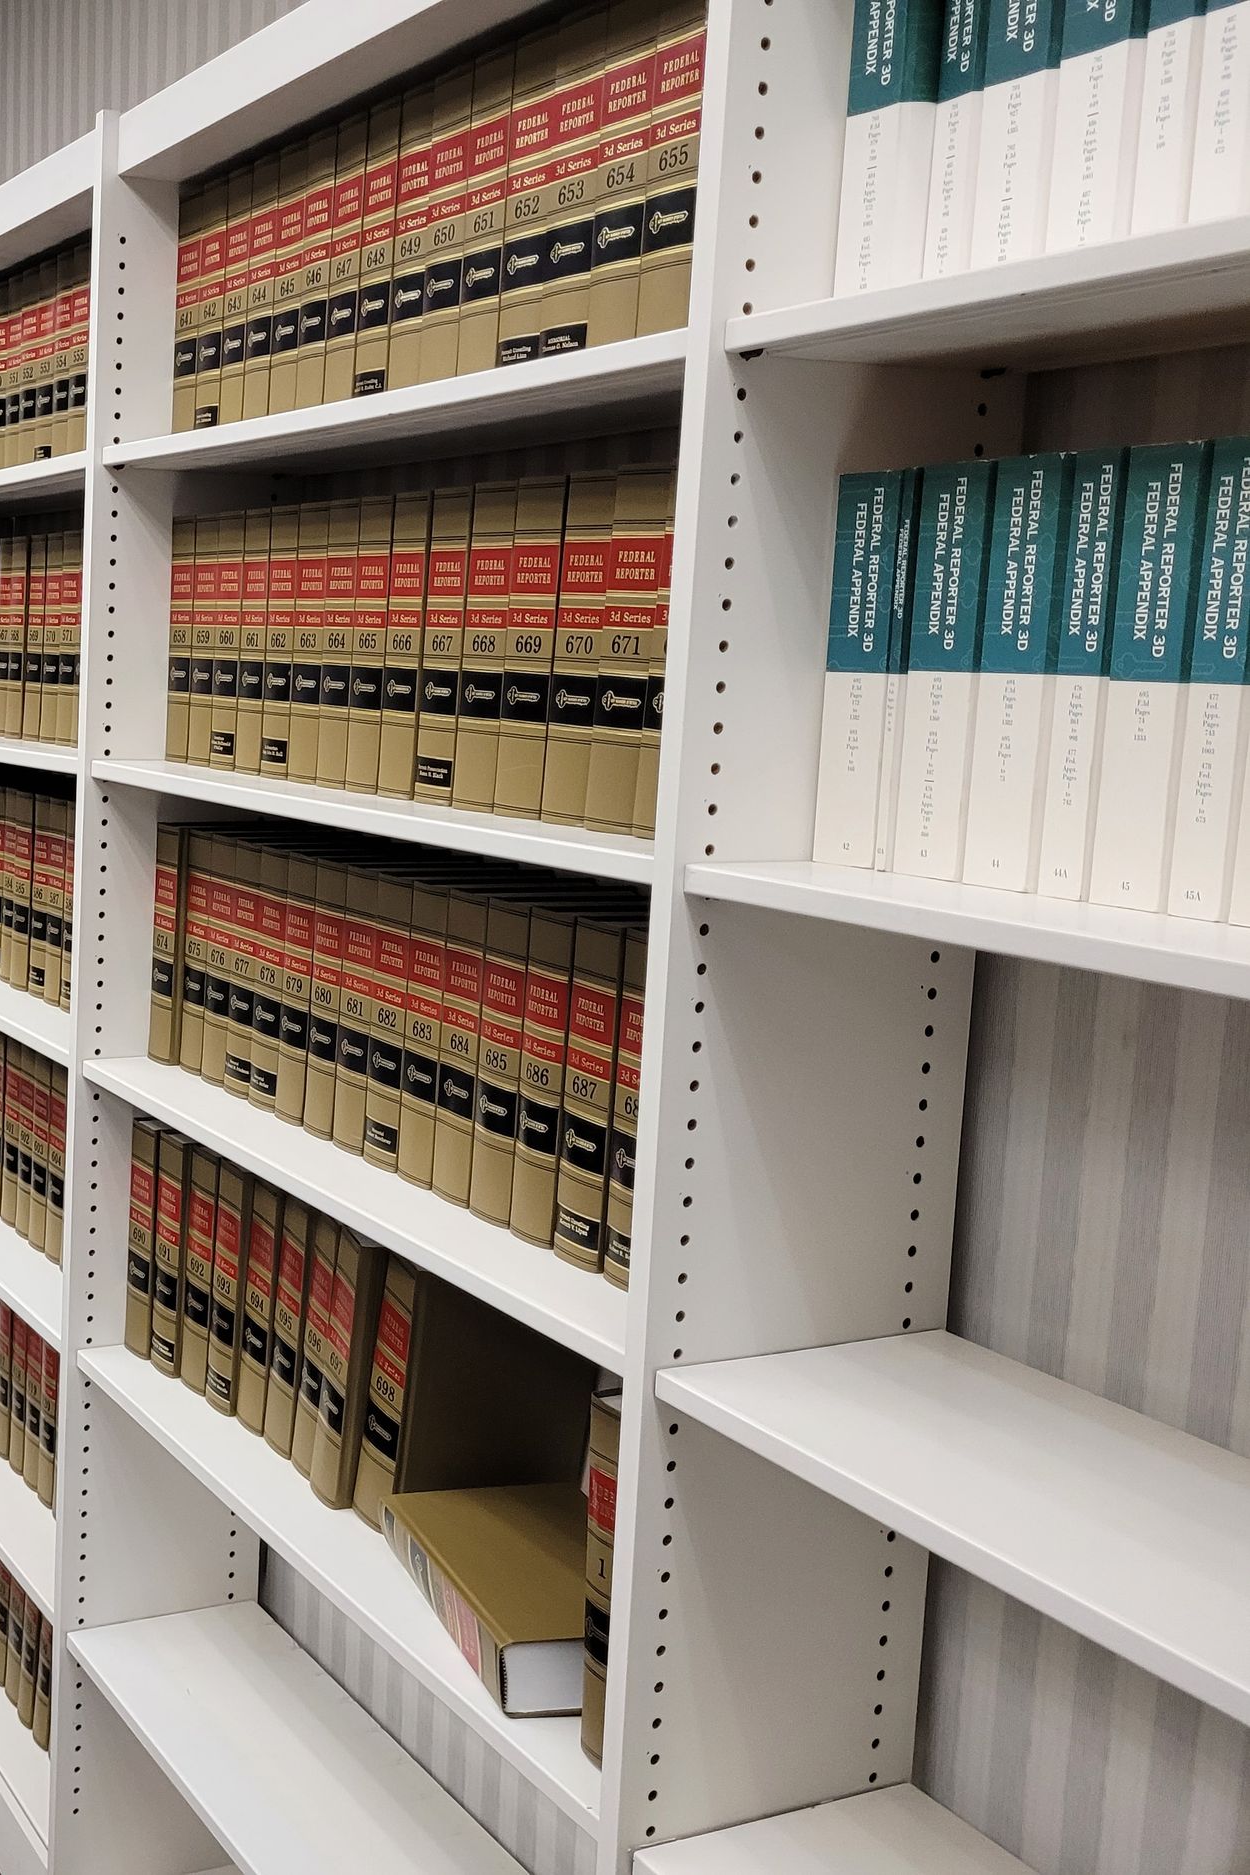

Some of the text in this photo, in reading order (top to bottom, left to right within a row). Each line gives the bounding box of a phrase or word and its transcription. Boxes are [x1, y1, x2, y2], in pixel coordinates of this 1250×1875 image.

[1104, 0, 1116, 22] 3D
[866, 1, 880, 75] APPENDIX
[947, 0, 961, 62] PPENDIX
[960, 0, 974, 72] ORTER 3D
[1022, 28, 1034, 52] 3D
[881, 0, 896, 85] PORTER 3D
[663, 51, 699, 75] FEDERAL
[610, 72, 646, 95] FEDERAL
[660, 69, 700, 93] REPORTER
[562, 94, 594, 115] FEDERAL
[608, 90, 646, 113] REPORTER
[518, 112, 548, 132] FEDERAL
[559, 111, 594, 132] REPORTER
[656, 119, 696, 140] 3d Series
[477, 130, 503, 149] FEDERAL
[516, 128, 548, 148] REPORTER
[475, 146, 503, 165] REPORTER
[604, 138, 643, 158] 3d Series
[659, 144, 688, 171] 655
[556, 156, 591, 175] 3d Series
[606, 162, 635, 188] 654
[512, 172, 545, 190] 3d Series
[471, 188, 501, 205] 3d Series
[558, 180, 584, 205] 653
[514, 195, 540, 219] 652
[474, 210, 494, 233] 651
[434, 224, 455, 246] 650
[400, 236, 421, 258] 649
[366, 248, 385, 268] 648
[305, 267, 322, 285] 646
[335, 259, 352, 277] 647
[252, 286, 267, 303] 644
[280, 278, 295, 297] 645
[203, 302, 217, 319] 642
[227, 295, 242, 313] 643
[179, 311, 193, 328] 641
[476, 559, 505, 571] FEDERAL
[519, 556, 551, 568] FEDERAL
[569, 555, 604, 566] FEDERAL
[618, 550, 656, 563] FEDERAL
[928, 494, 950, 635] FEDERAL APPENDIX
[943, 476, 967, 650] FEDERAL REPORTER 3D
[1001, 488, 1024, 635] FEDERAL APPENDIX
[1017, 470, 1043, 651] FEDERAL REPORTER 3D
[1068, 482, 1094, 636] FEDERAL APPENDIX
[1085, 464, 1113, 652] FEDERAL REPORTER 3D
[1133, 481, 1161, 640] FEDERAL APPENDIX
[1152, 463, 1183, 658] FEDERAL REPORTER 3D
[1203, 476, 1233, 641] FEDERAL APPENDIX
[516, 572, 551, 584] REPORTER
[567, 571, 603, 583] REPORTER
[615, 567, 655, 580] REPORTER
[848, 503, 867, 637] FEDERAL APPENDIX
[863, 487, 884, 652] FEDERAL REPORTER 3D
[475, 575, 505, 586] REPORTER
[1225, 539, 1247, 630] REPORTER
[470, 613, 502, 624] 3d Series
[512, 613, 548, 624] 3d Series
[562, 612, 600, 625] 3d Series
[609, 611, 651, 624] 3d Series
[173, 629, 186, 643] 658
[196, 630, 210, 644] 659
[219, 631, 234, 645] 660
[246, 632, 259, 647] 661
[271, 633, 286, 648] 662
[300, 633, 316, 649] 663
[328, 633, 345, 649] 664
[358, 634, 377, 649] 665
[393, 634, 412, 650] 666
[432, 635, 453, 652] 667
[472, 635, 496, 653] 668
[515, 635, 542, 654] 669
[565, 635, 593, 655] 670
[611, 635, 640, 656] 671
[1223, 635, 1237, 659] 3D
[156, 934, 168, 950] 674
[188, 941, 201, 957] 675
[210, 949, 224, 966] 676
[235, 957, 250, 975] 677
[260, 966, 275, 984] 678
[452, 961, 478, 977] FEDERAL
[286, 975, 302, 993] 679
[451, 976, 477, 992] REPORTER
[490, 974, 516, 991] FEDERAL
[314, 986, 332, 1005] 680
[488, 989, 516, 1006] REPORTER
[530, 985, 558, 1003] FEDERAL
[346, 997, 364, 1016] 681
[528, 1000, 558, 1019] REPORTER
[578, 998, 604, 1016] FEDERAL
[378, 1008, 396, 1027] 682
[448, 1012, 474, 1028] 3d Series
[576, 1014, 604, 1032] REPORTER
[413, 1021, 432, 1040] 683
[485, 1025, 514, 1044] 3d Series
[450, 1034, 469, 1054] 684
[525, 1039, 555, 1057] 3d Series
[486, 1049, 507, 1070] 685
[571, 1054, 603, 1073] 3d Series
[526, 1063, 549, 1085] 686
[572, 1076, 597, 1099] 687
[133, 1227, 145, 1244] 690
[190, 1258, 204, 1277] 692
[216, 1275, 230, 1295] 693
[251, 1291, 264, 1312] 694
[279, 1309, 292, 1330] 695
[308, 1329, 321, 1352] 696
[330, 1352, 343, 1375] 697
[376, 1376, 395, 1402] 698
[599, 1559, 606, 1579] 1
